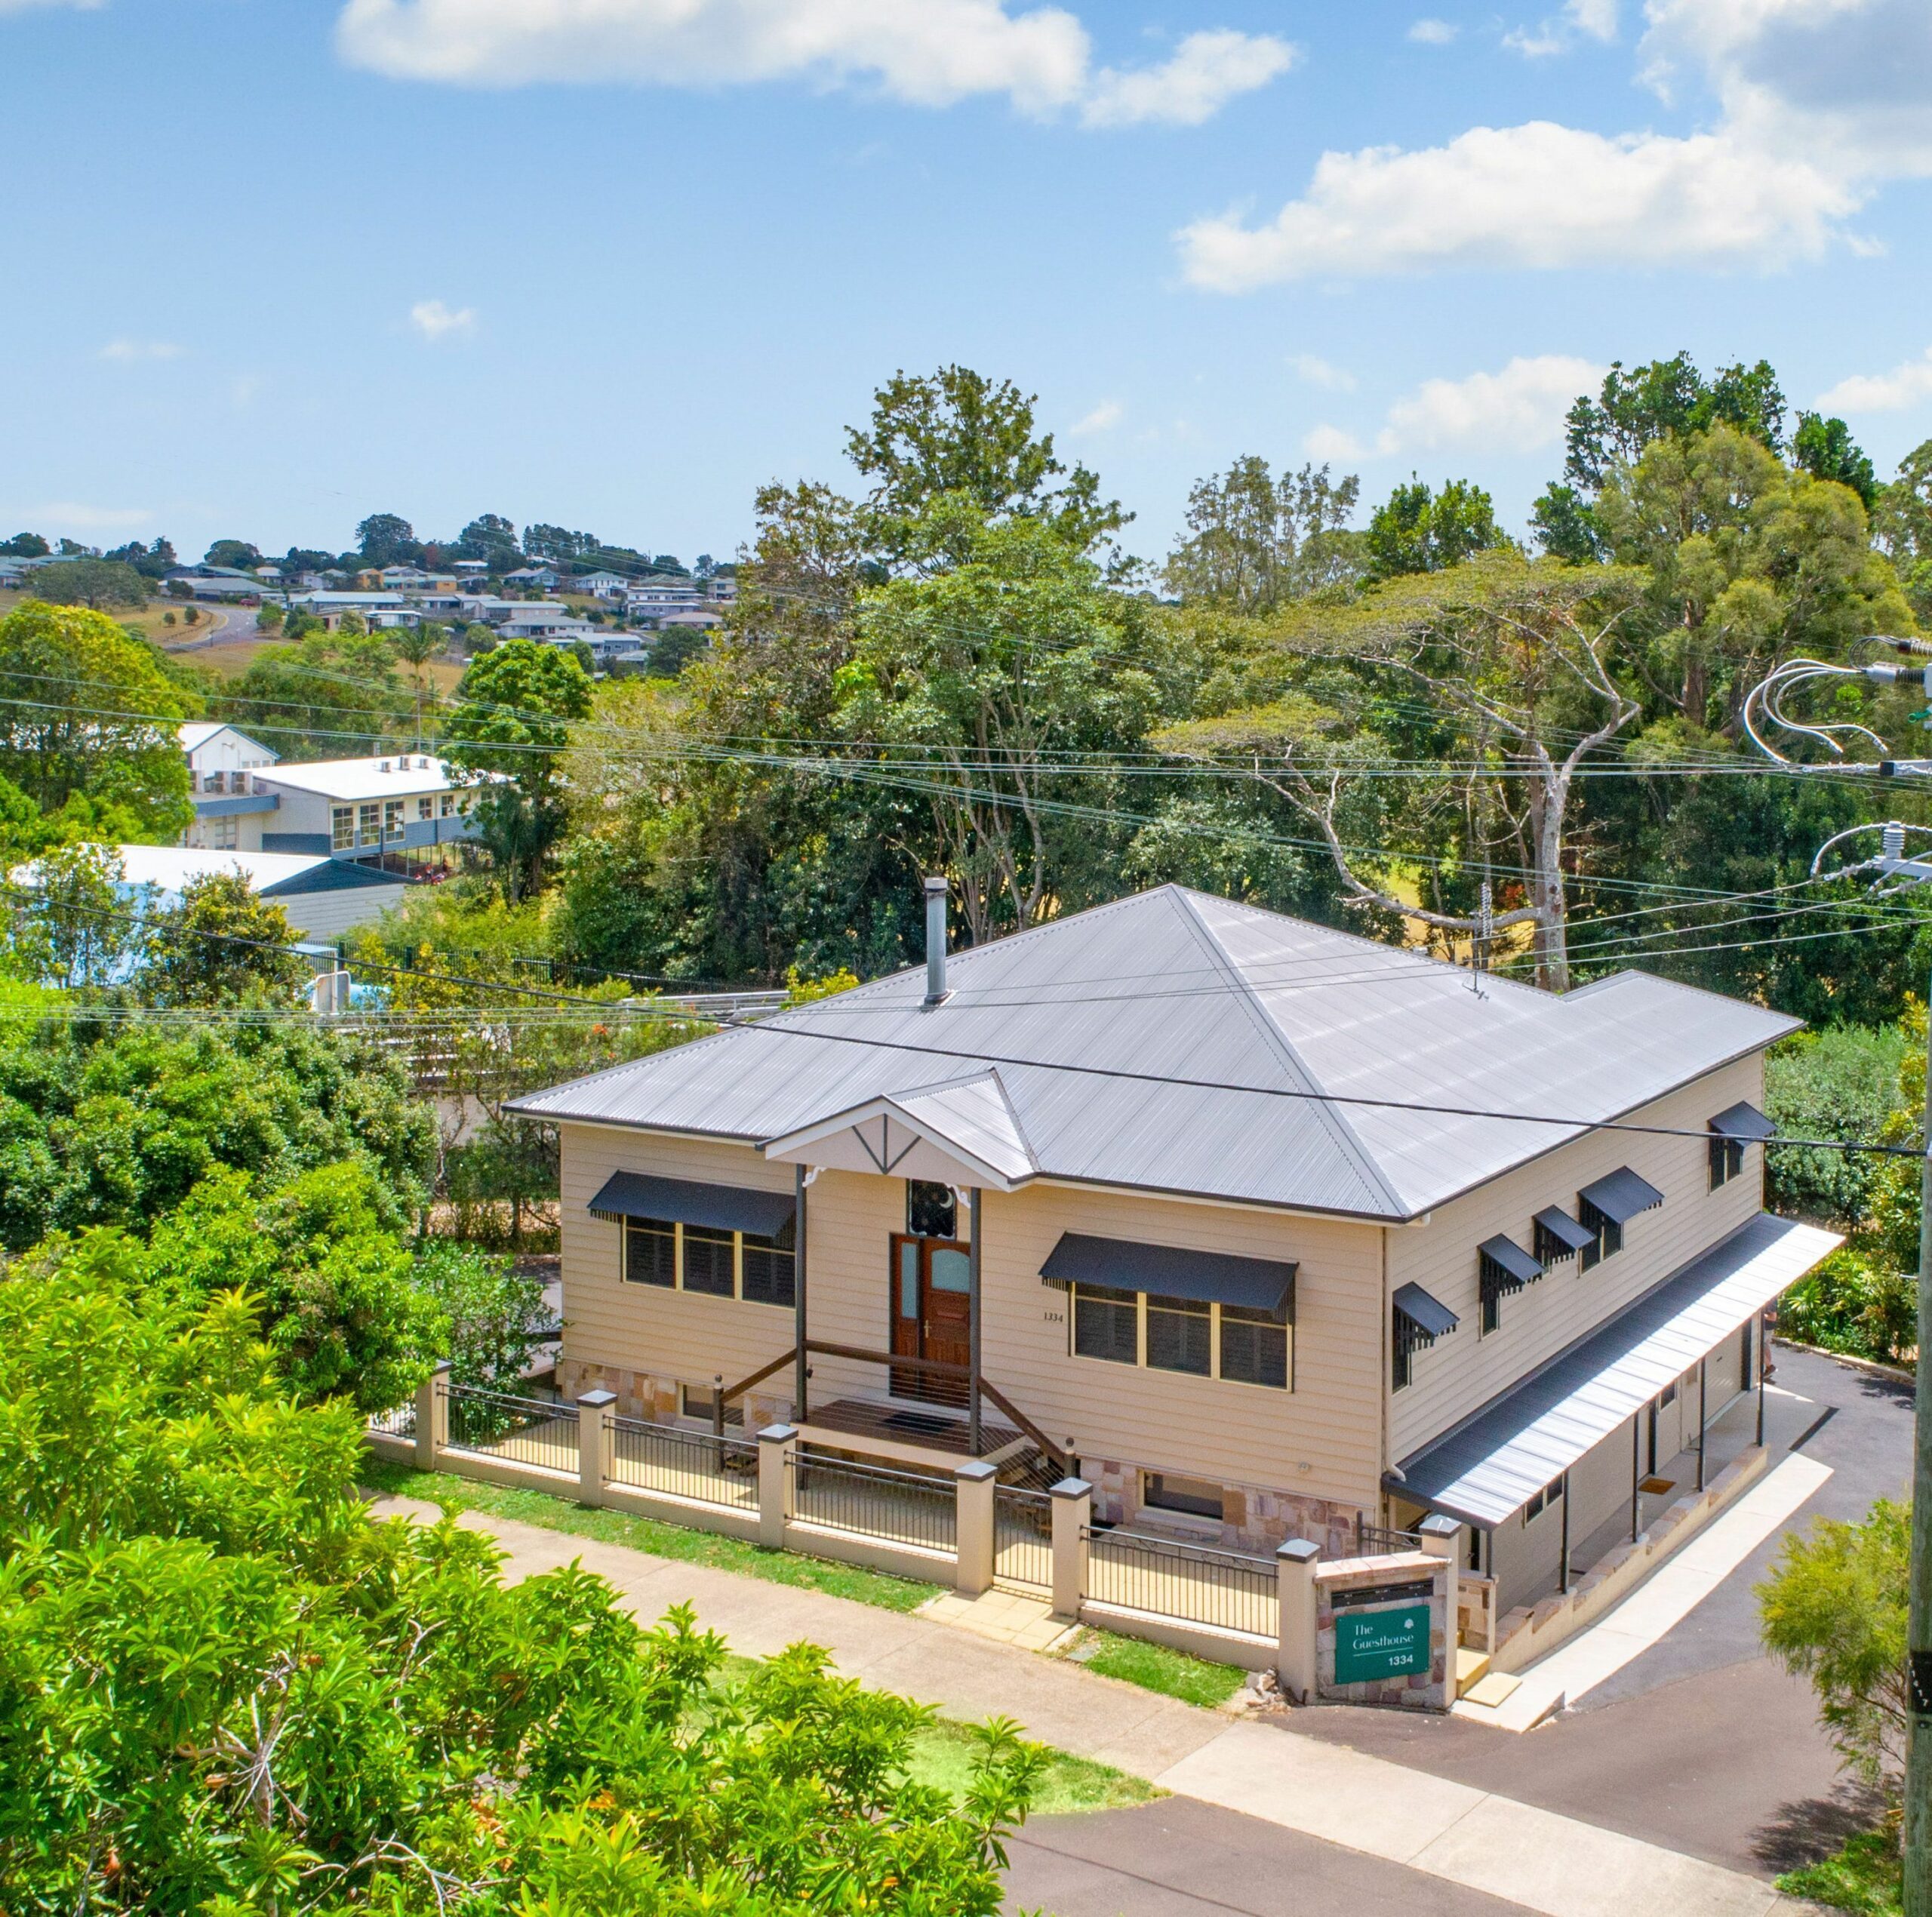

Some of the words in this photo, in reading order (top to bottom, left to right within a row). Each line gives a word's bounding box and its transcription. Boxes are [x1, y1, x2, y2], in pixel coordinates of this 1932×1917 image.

[1044, 1312, 1063, 1323] 1334
[1355, 1624, 1374, 1635] The
[1353, 1634, 1414, 1650] Guesthouse
[1389, 1654, 1414, 1666] 1334
